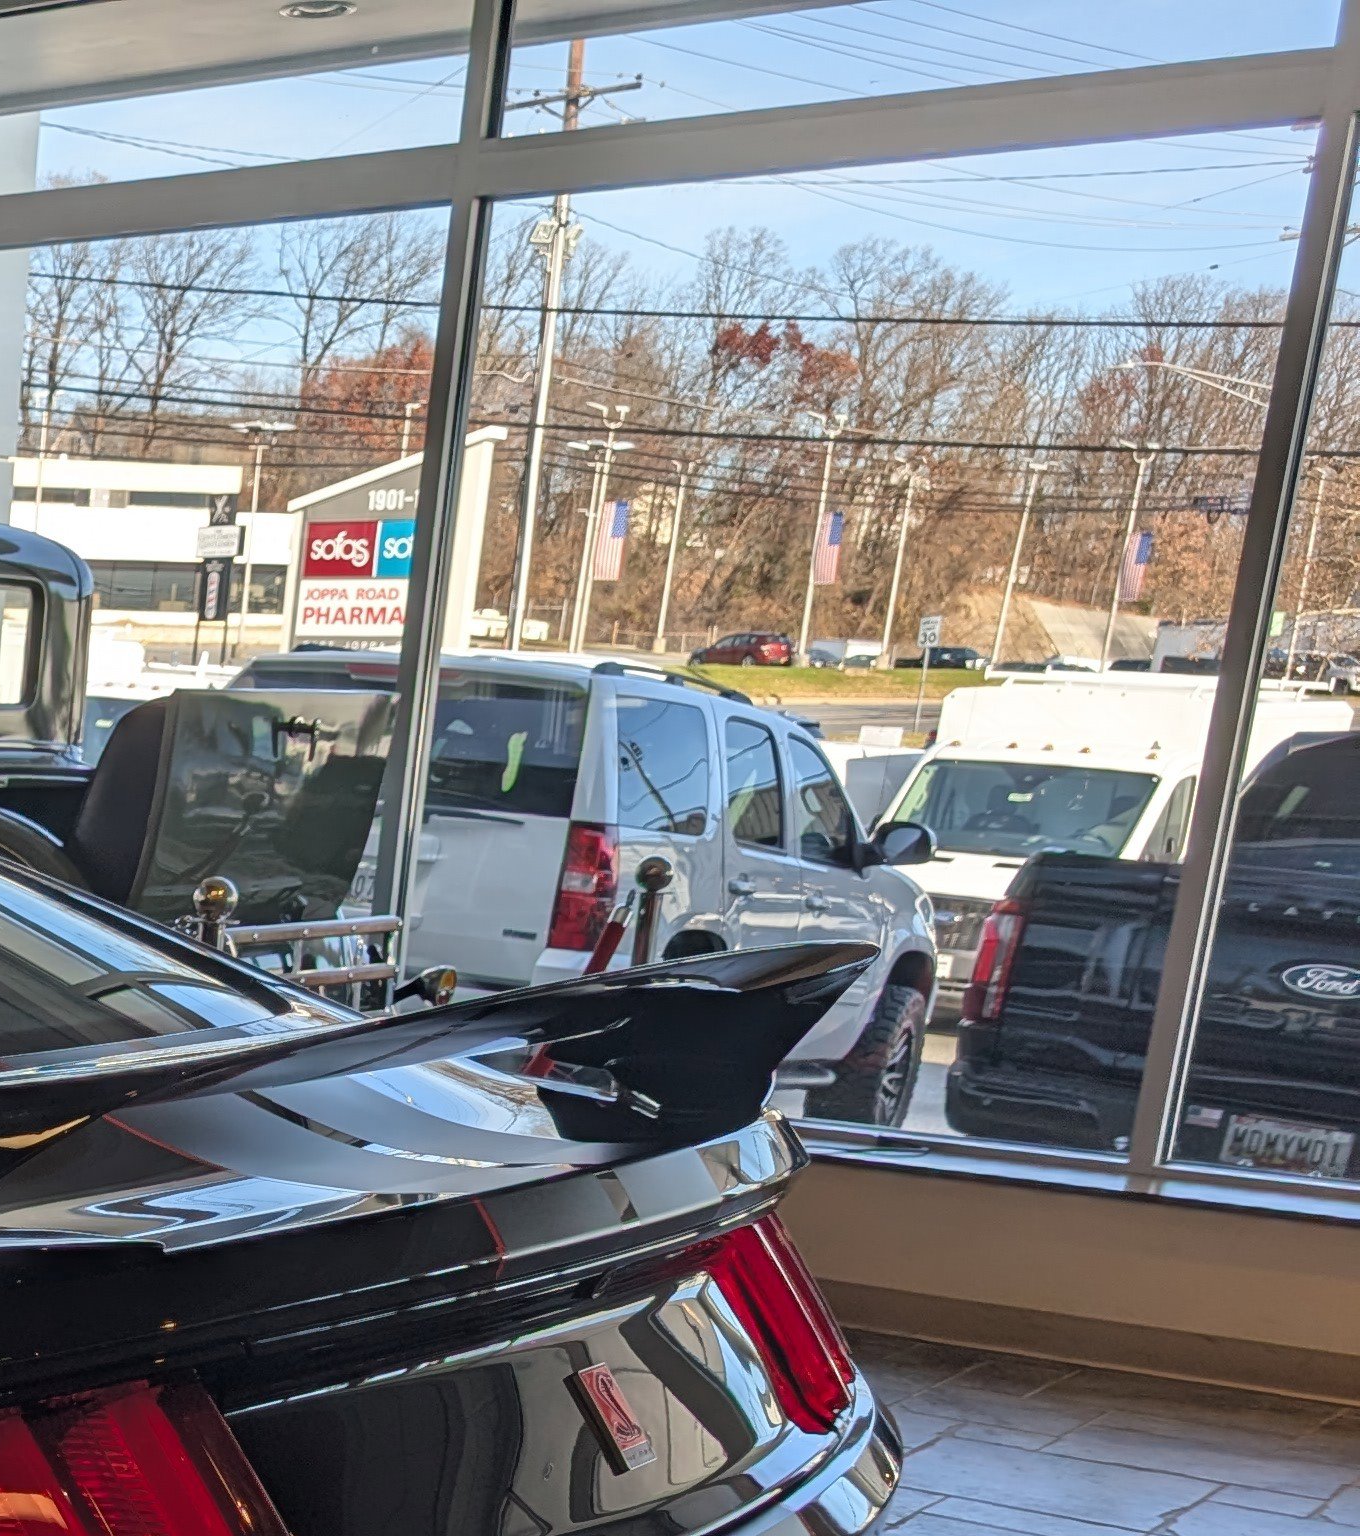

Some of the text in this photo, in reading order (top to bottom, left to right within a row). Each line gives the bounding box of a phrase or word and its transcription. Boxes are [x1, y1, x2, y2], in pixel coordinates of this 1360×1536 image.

[310, 530, 370, 567] sofas
[305, 588, 399, 600] JOPPA ROAD
[920, 632, 936, 645] 30
[1298, 968, 1360, 994] Ford
